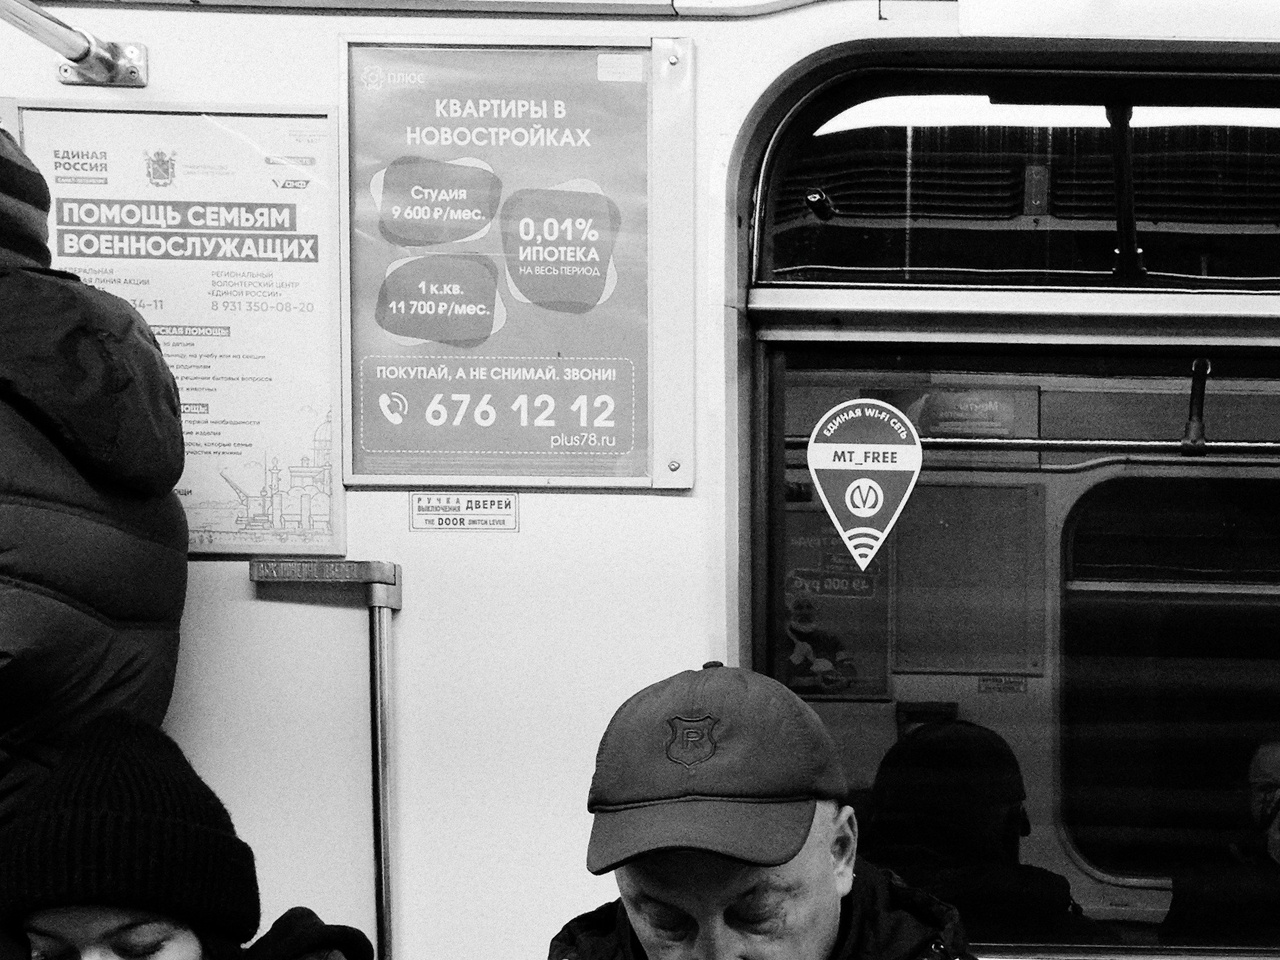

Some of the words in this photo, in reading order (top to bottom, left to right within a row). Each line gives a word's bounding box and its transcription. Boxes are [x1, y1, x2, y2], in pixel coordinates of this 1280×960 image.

[388, 73, 425, 84] ПЛЮС
[435, 99, 548, 118] КВАРТИРЫ
[554, 100, 566, 118] В
[406, 124, 591, 147] НОВОСТРОЙКАХ
[53, 150, 107, 160] ЕДИНАЯ
[54, 161, 108, 172] РОССИЯ
[411, 186, 467, 203] Студия
[62, 202, 181, 228] ПОМОЩЬ
[187, 206, 290, 228] СЕМЬЯМ
[392, 207, 400, 218] 9
[402, 207, 430, 220] 600
[519, 217, 599, 243] 0,01%
[64, 234, 315, 262] ВОЕННОСЛУЖАЩИХ
[519, 246, 600, 262] ИПОТЕКА
[520, 266, 533, 275] НА
[535, 266, 559, 275] ВЕСЬ
[561, 266, 600, 277] ПЕРИОД
[211, 280, 273, 289] ВОЛОНТЕРСКИЙ
[276, 281, 300, 289] ЦЕНТР
[418, 281, 426, 294] 1
[207, 290, 244, 298] «ЕДИНОЙ
[245, 290, 282, 298] РОССИИ»
[211, 301, 219, 311] 8
[222, 301, 242, 311] 931
[246, 301, 314, 313] 350-08-20
[389, 301, 407, 314] 11
[411, 301, 435, 315] 700
[376, 365, 452, 381] ПОКУПАЙ,
[456, 368, 467, 380] А
[470, 368, 487, 380] НЕ
[491, 366, 560, 381] СНИМАЙ.
[564, 368, 616, 381] ЗВОНИ!
[425, 393, 497, 427] 676
[510, 394, 555, 427] 12
[570, 394, 615, 427] 12
[823, 408, 862, 437] ЕДИНАЯ
[890, 418, 908, 440] СЕТЬ
[550, 432, 616, 448] plus78.ru
[832, 450, 898, 466] MT_FREE
[466, 498, 511, 510] ДВЕРЕЙ
[438, 518, 465, 526] DOOR
